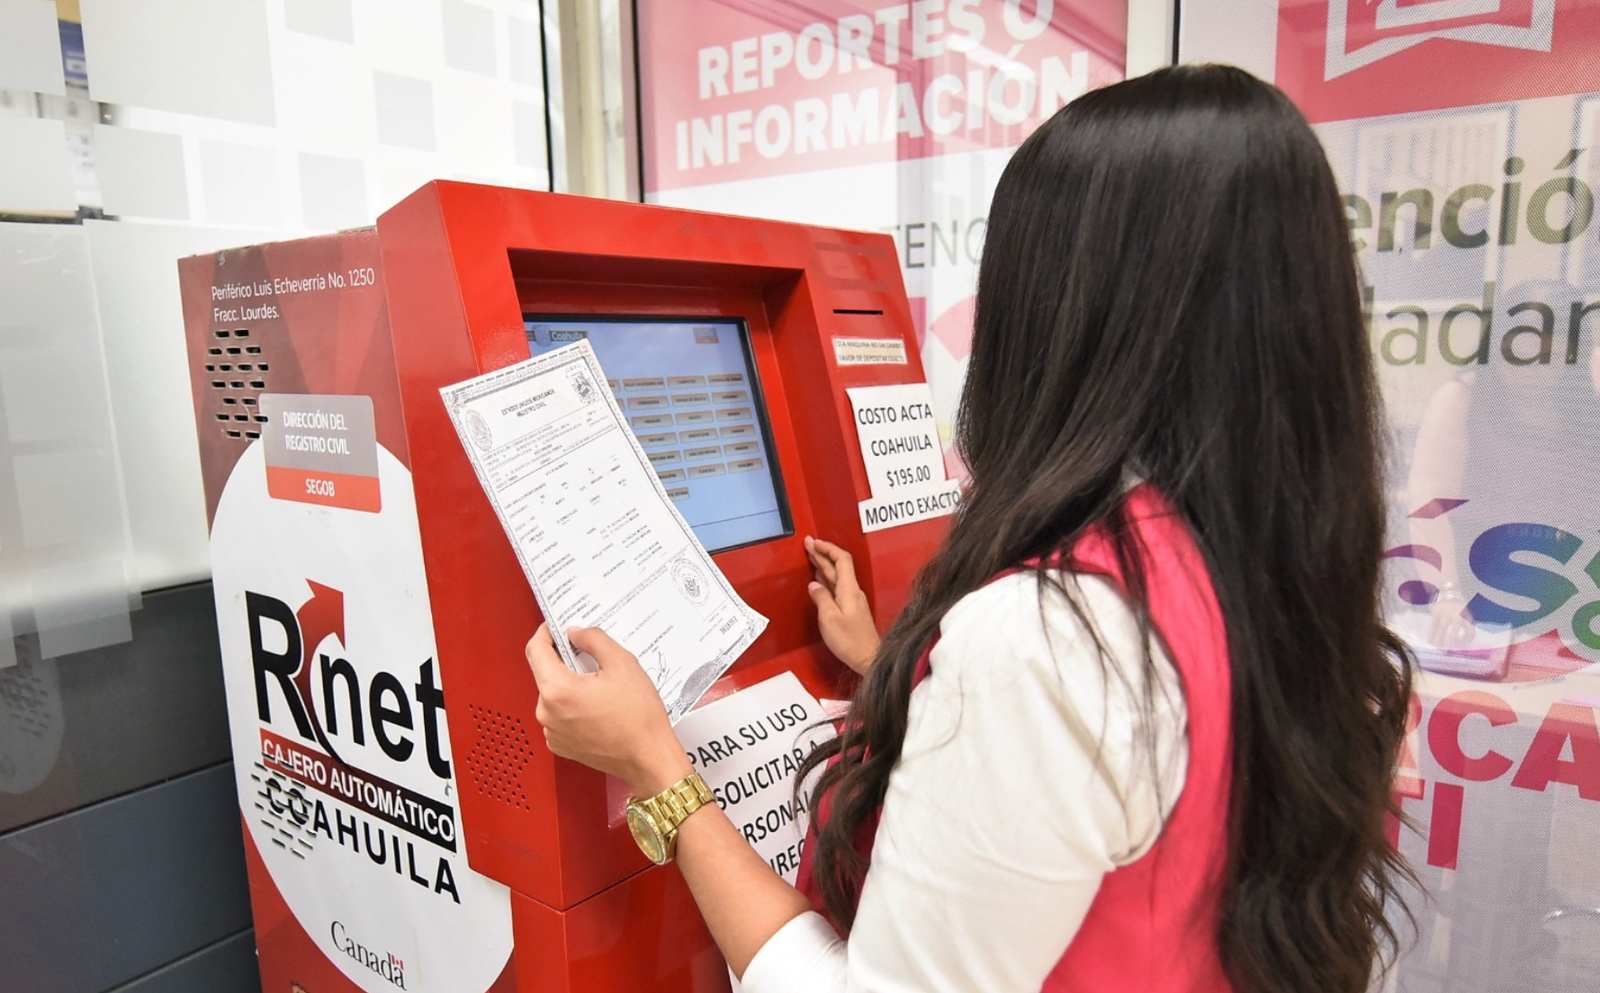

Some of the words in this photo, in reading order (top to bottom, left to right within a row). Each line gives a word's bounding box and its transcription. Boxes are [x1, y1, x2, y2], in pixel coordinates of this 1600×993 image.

[698, 0, 986, 100] REPORTES
[676, 43, 1089, 171] INFORMACIÓN
[1340, 147, 1600, 252] enció
[211, 283, 252, 301] Periférico
[253, 281, 273, 297] Luis
[273, 273, 326, 295] Echeverría
[328, 272, 347, 289] No.
[348, 267, 375, 287] 1250
[214, 307, 240, 322] Fracc.
[241, 303, 280, 321] Lourdes.
[283, 410, 329, 430] DIRECCIÓN
[329, 413, 348, 431] DEL
[858, 406, 897, 425] COSTO
[901, 403, 933, 421] ACTA
[285, 434, 326, 453] REGISTRO
[327, 437, 350, 455] CIVIL
[871, 434, 933, 456] COAHUILA
[305, 478, 336, 497] SEGOB
[886, 465, 931, 488] $195.00
[865, 500, 915, 526] MONTO
[917, 490, 960, 514] EXACTO
[245, 590, 452, 779] Rnet
[739, 721, 768, 746] SU
[767, 703, 808, 732] USO
[263, 739, 327, 785] CAJERO
[330, 765, 455, 842] AUTOMÁTICO
[713, 747, 806, 811] SOLICITAR
[738, 791, 809, 844] RSONA
[266, 777, 461, 905] COAHUILA
[331, 921, 407, 991] Canada
